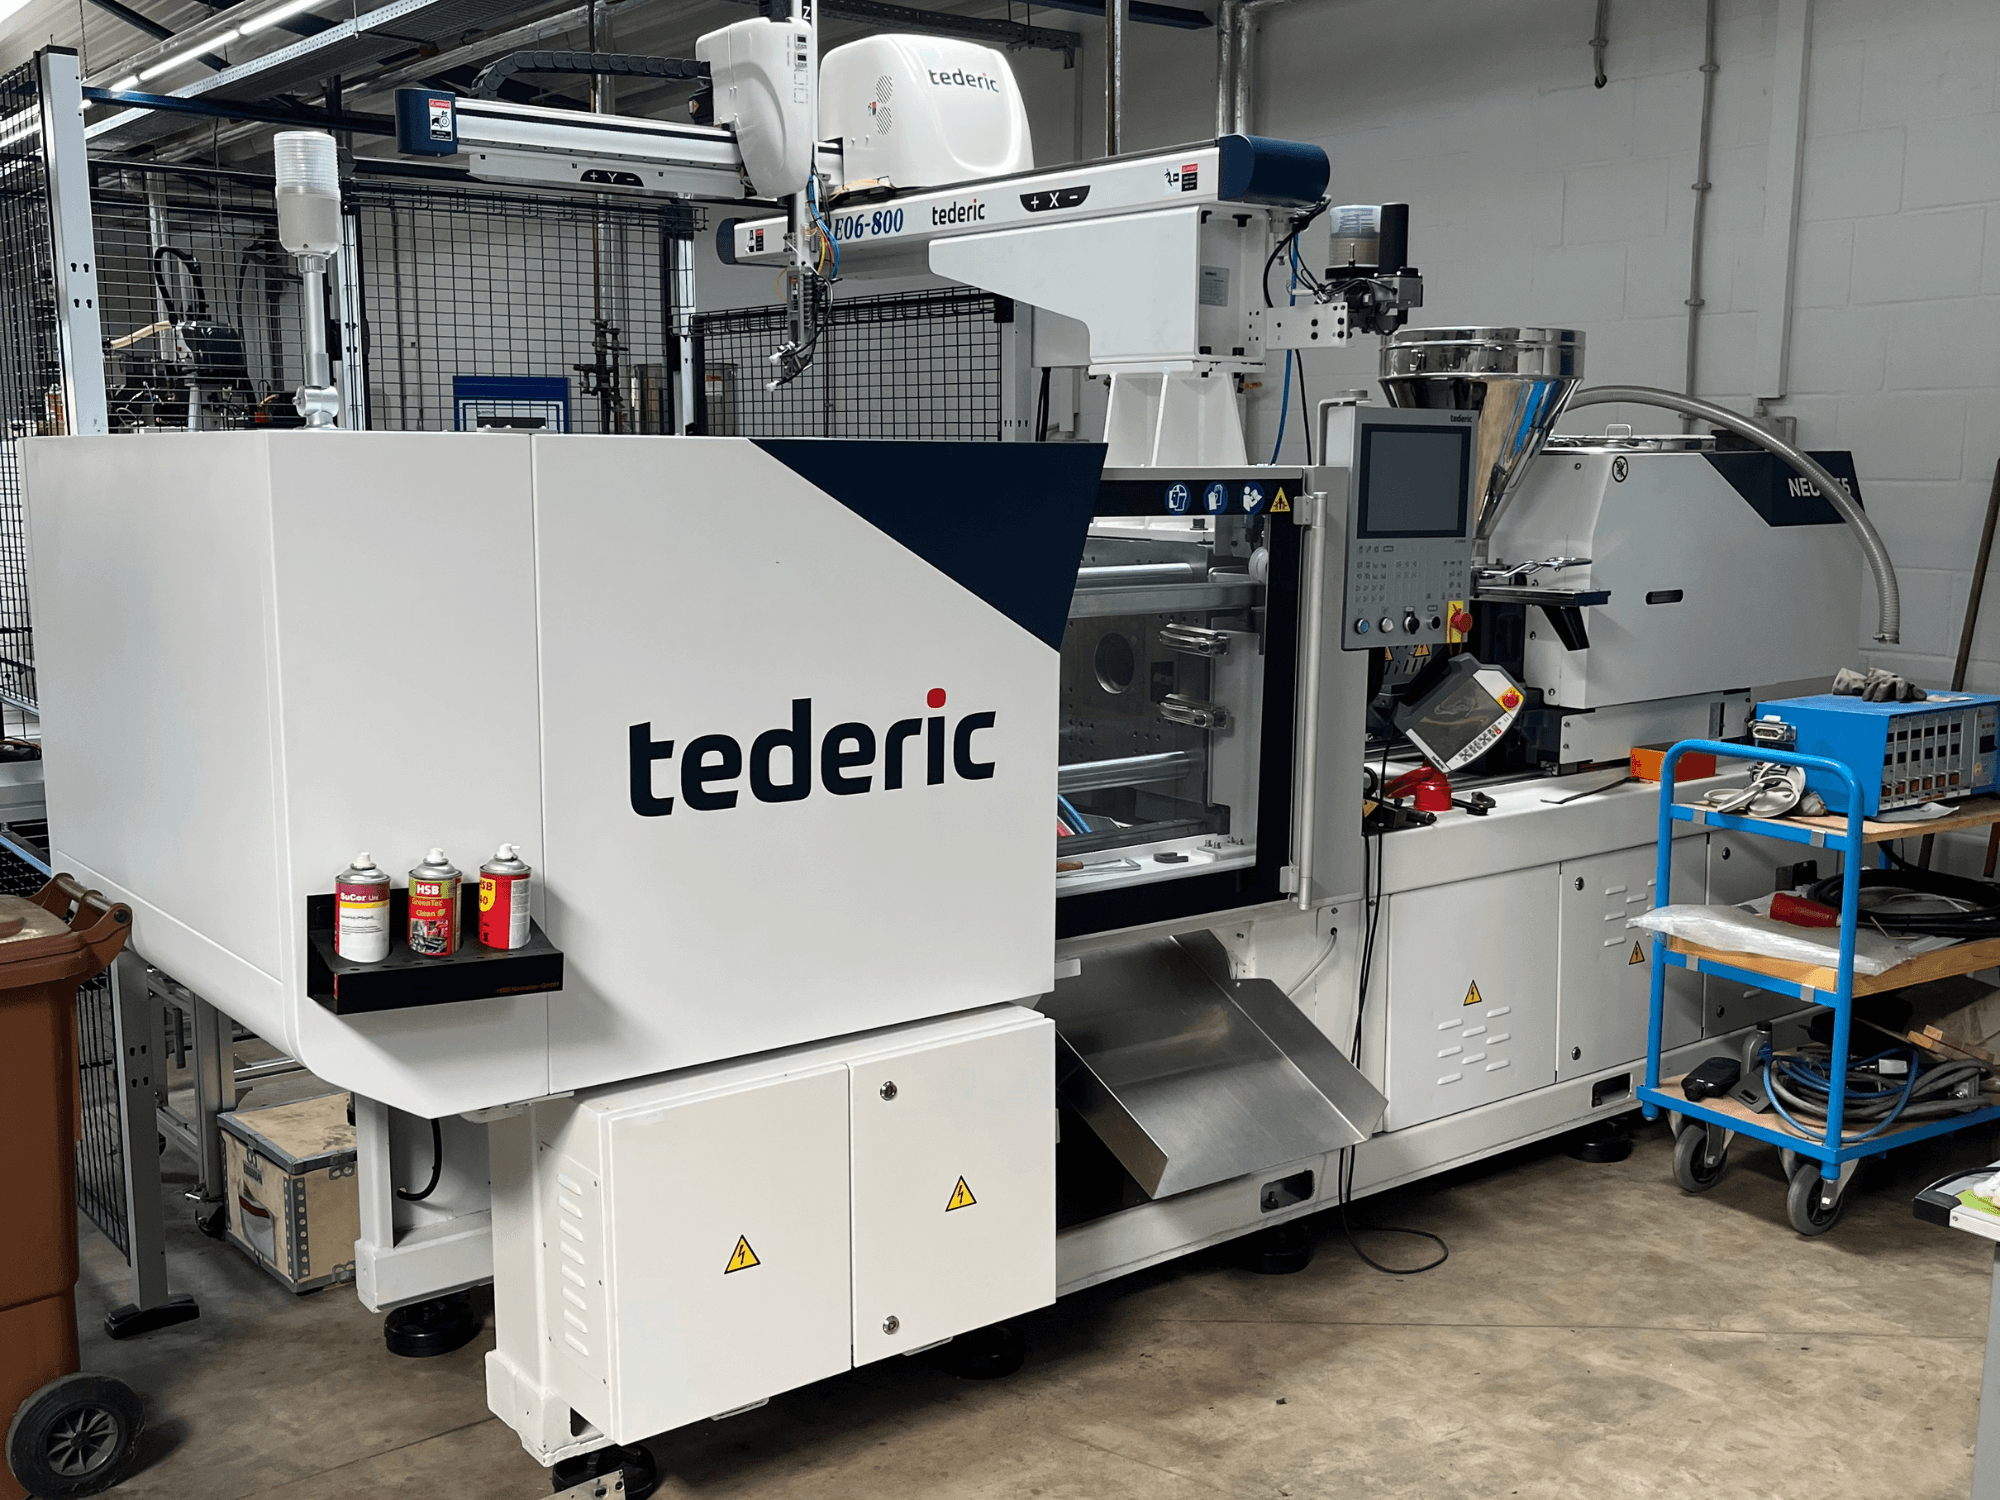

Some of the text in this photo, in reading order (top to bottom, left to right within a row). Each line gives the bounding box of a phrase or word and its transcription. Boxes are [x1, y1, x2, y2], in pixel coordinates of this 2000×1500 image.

[802, 5, 811, 19] Z
[928, 68, 999, 93] tederic
[607, 172, 617, 183] Y
[1049, 192, 1060, 207] X
[932, 198, 985, 226] tederic
[1450, 414, 1473, 423] tederic
[629, 688, 996, 817] tederic
[416, 884, 440, 895] HSB
[340, 892, 367, 902] SuCor
